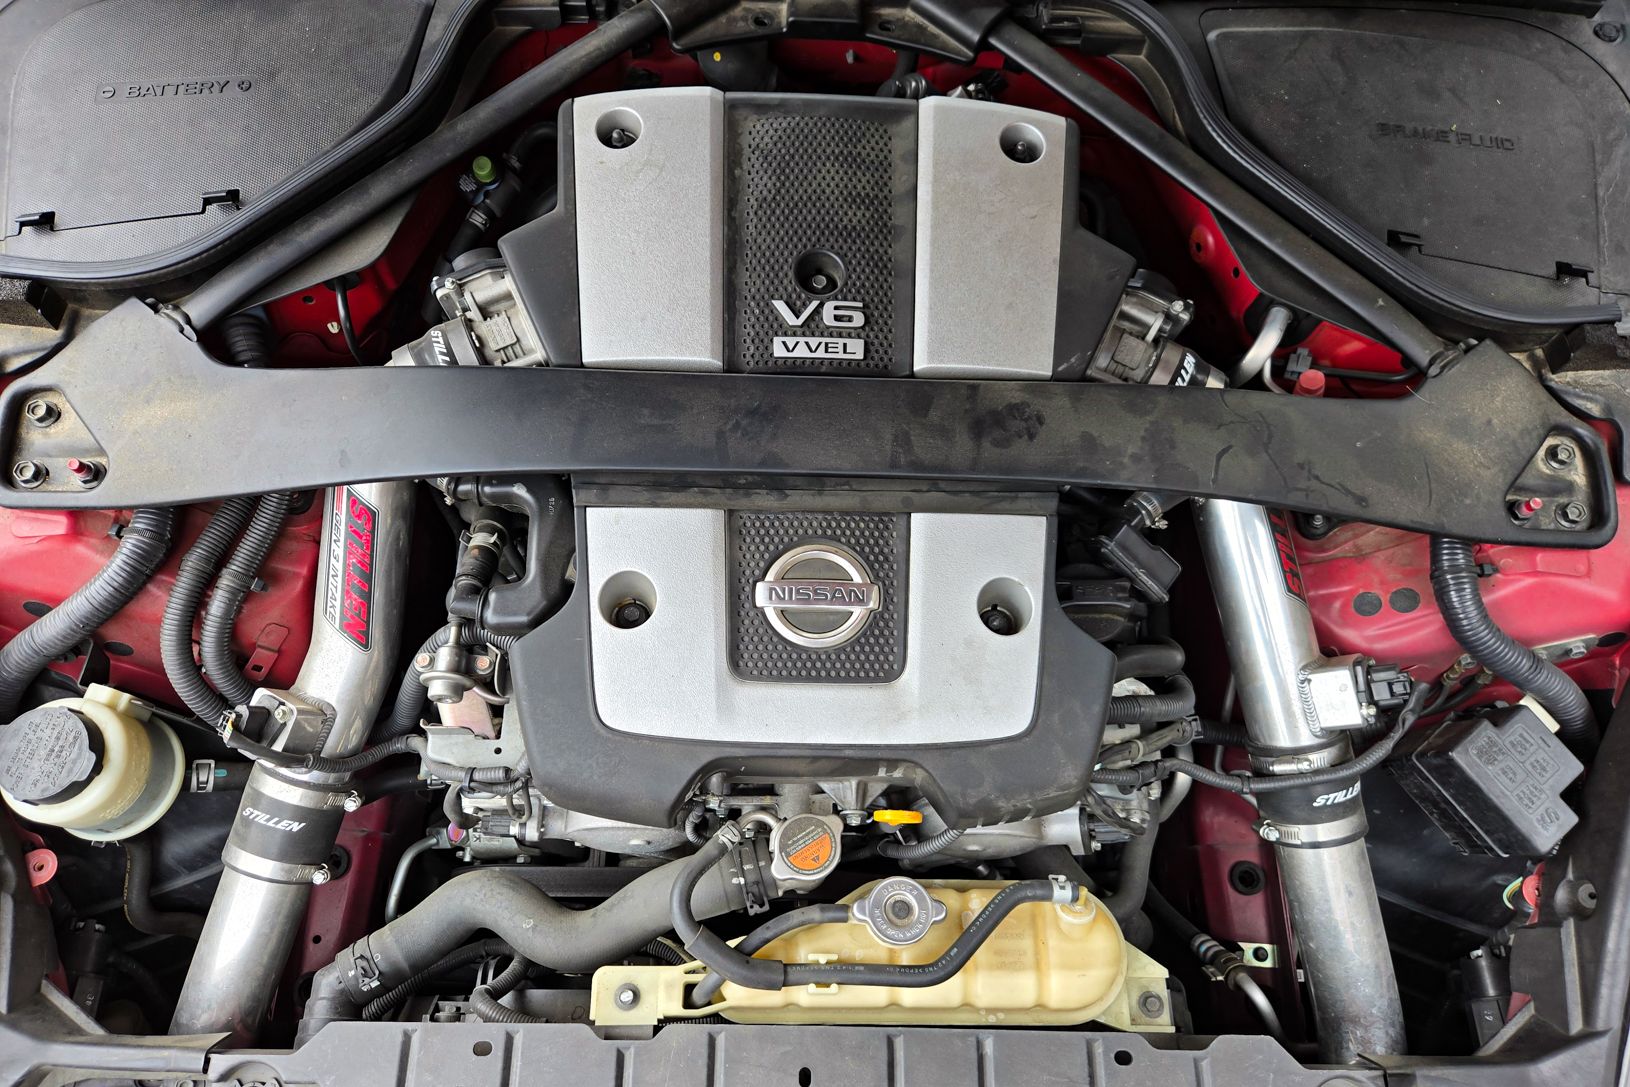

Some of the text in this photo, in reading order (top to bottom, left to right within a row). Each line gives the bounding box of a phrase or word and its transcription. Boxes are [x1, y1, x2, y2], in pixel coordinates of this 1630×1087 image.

[126, 80, 230, 98] BATTERY
[1376, 122, 1516, 150] BRAKE FLUID
[772, 300, 865, 327] V6
[431, 330, 450, 366] STILL
[781, 340, 857, 354] VVEL
[328, 511, 342, 625] GEN 3 INTAKE
[1269, 513, 1304, 599] STILL
[343, 496, 373, 645] STILLEN
[768, 585, 866, 602] NISSAN
[1312, 780, 1360, 806] STILLE
[242, 807, 306, 832] STILLEN
[882, 883, 918, 896] DANGER
